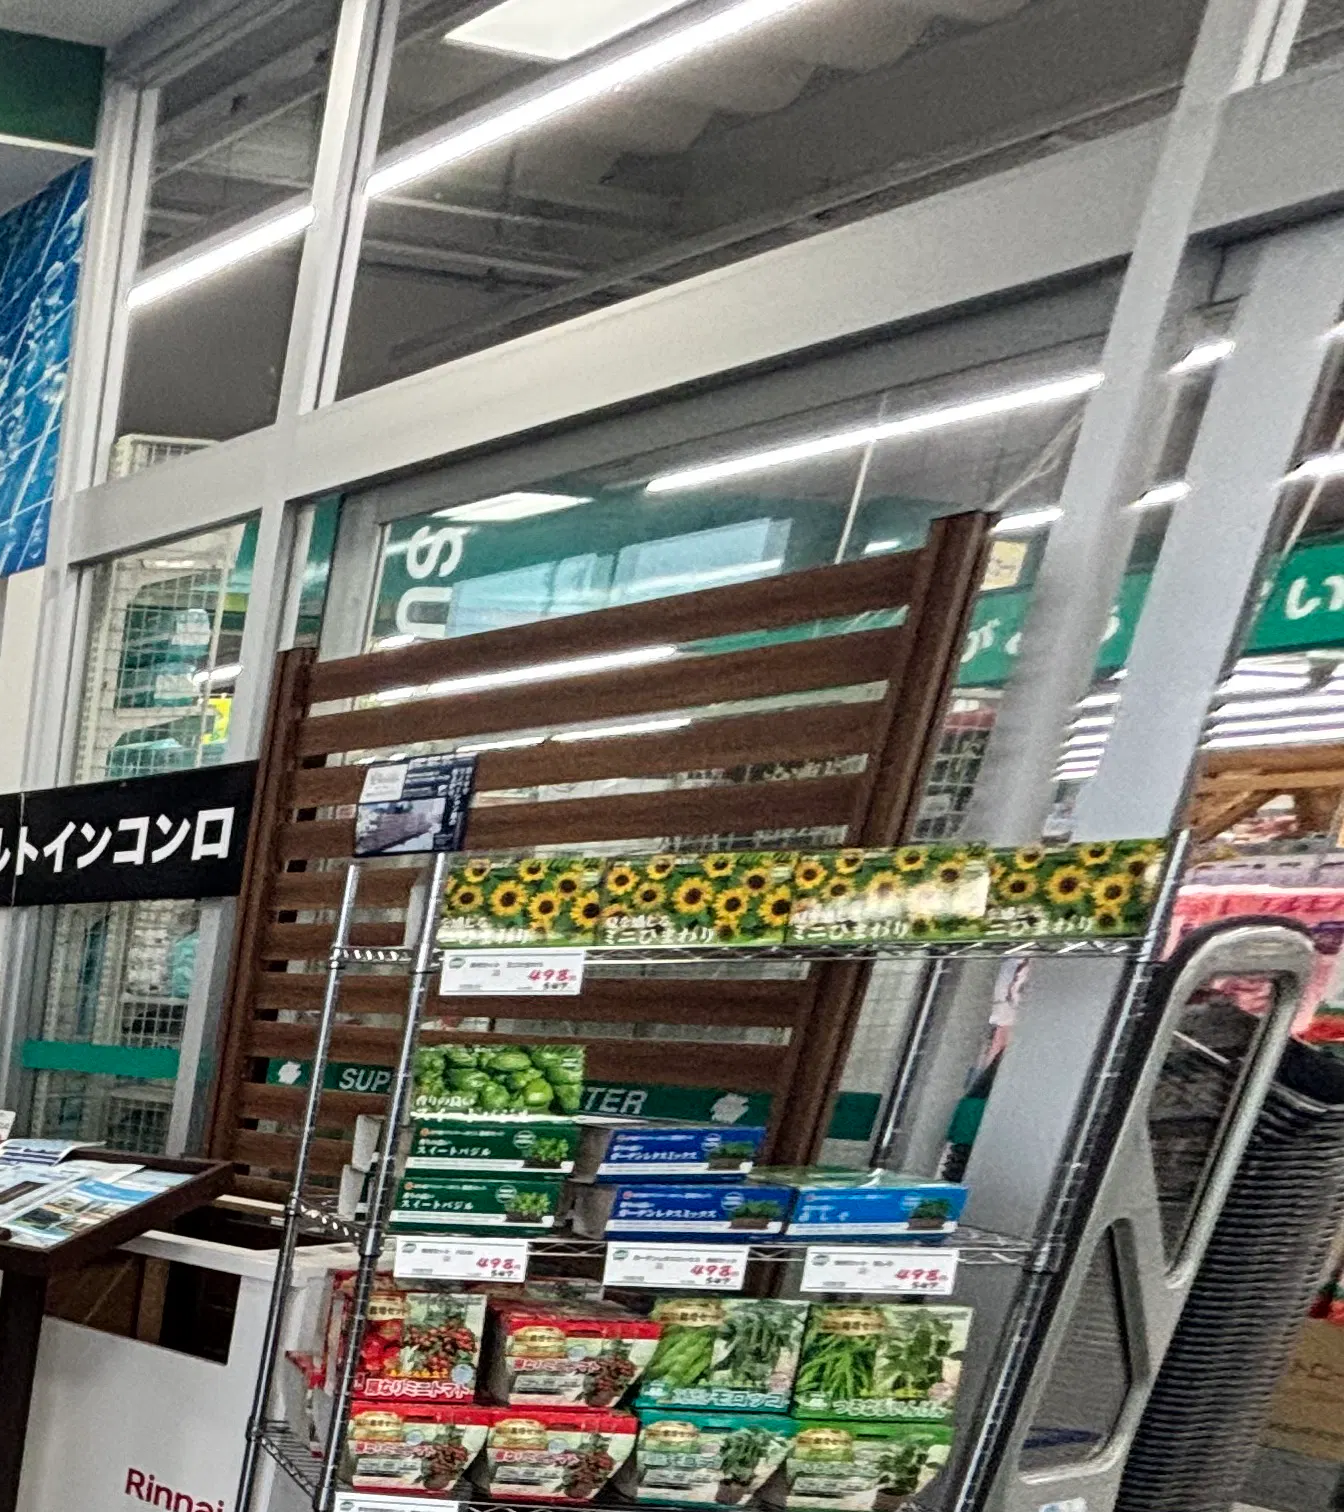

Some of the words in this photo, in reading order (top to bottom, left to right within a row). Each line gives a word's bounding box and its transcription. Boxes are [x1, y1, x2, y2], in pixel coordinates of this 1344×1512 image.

[984, 915, 1093, 938] ニひまわり
